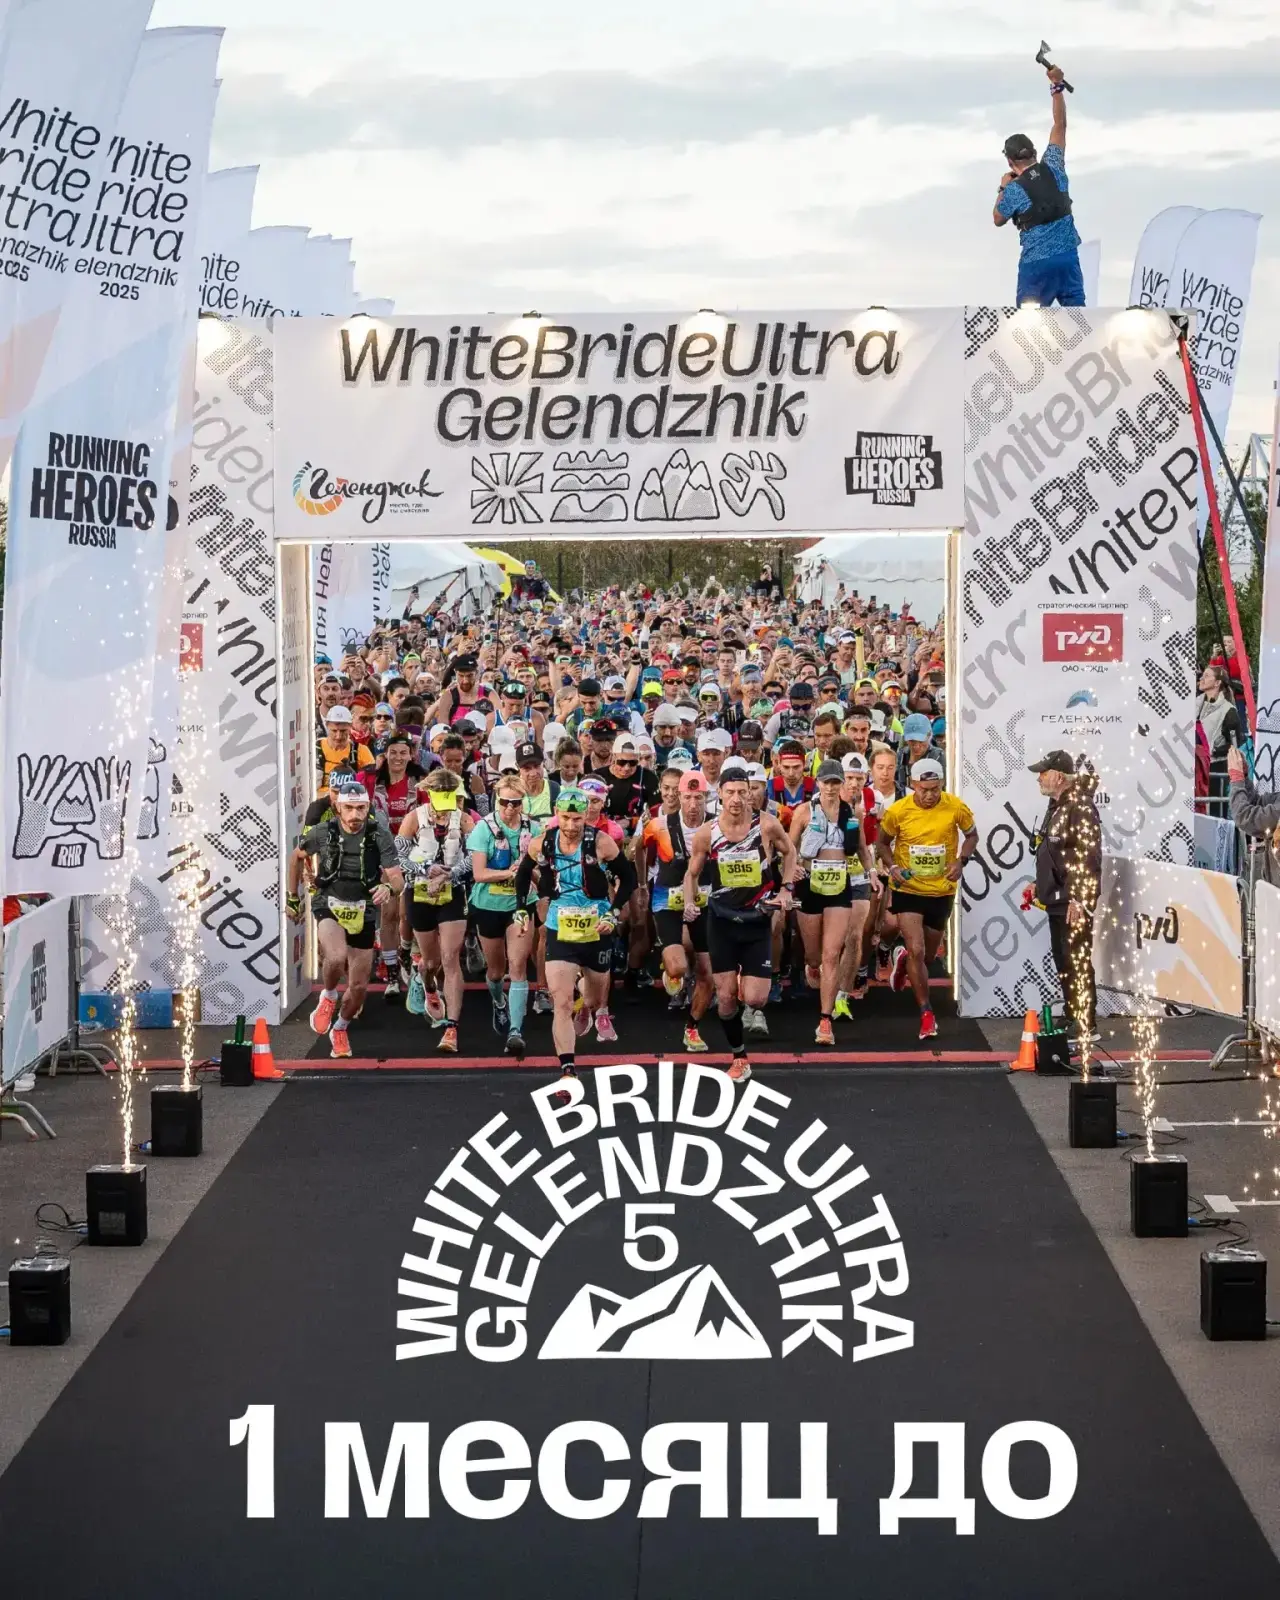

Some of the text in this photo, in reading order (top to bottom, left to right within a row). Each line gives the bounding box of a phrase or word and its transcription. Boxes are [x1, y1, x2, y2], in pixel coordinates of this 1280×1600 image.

[99, 281, 140, 300] 2025
[1182, 268, 1244, 318] White
[340, 322, 902, 384] WhiteBrideUltra
[437, 382, 807, 443] Gelendzhik
[48, 431, 151, 477] RUNNING
[860, 435, 927, 459] RUNNING
[852, 456, 936, 490] HEROES
[30, 467, 158, 531] HEROES
[876, 488, 912, 504] RUSSIA
[68, 522, 117, 550] RUSSIA
[1061, 664, 1079, 673] ОАО
[727, 864, 752, 874] 3815
[915, 856, 940, 865] 3823
[818, 872, 841, 881] 3775
[565, 917, 591, 929] 3767
